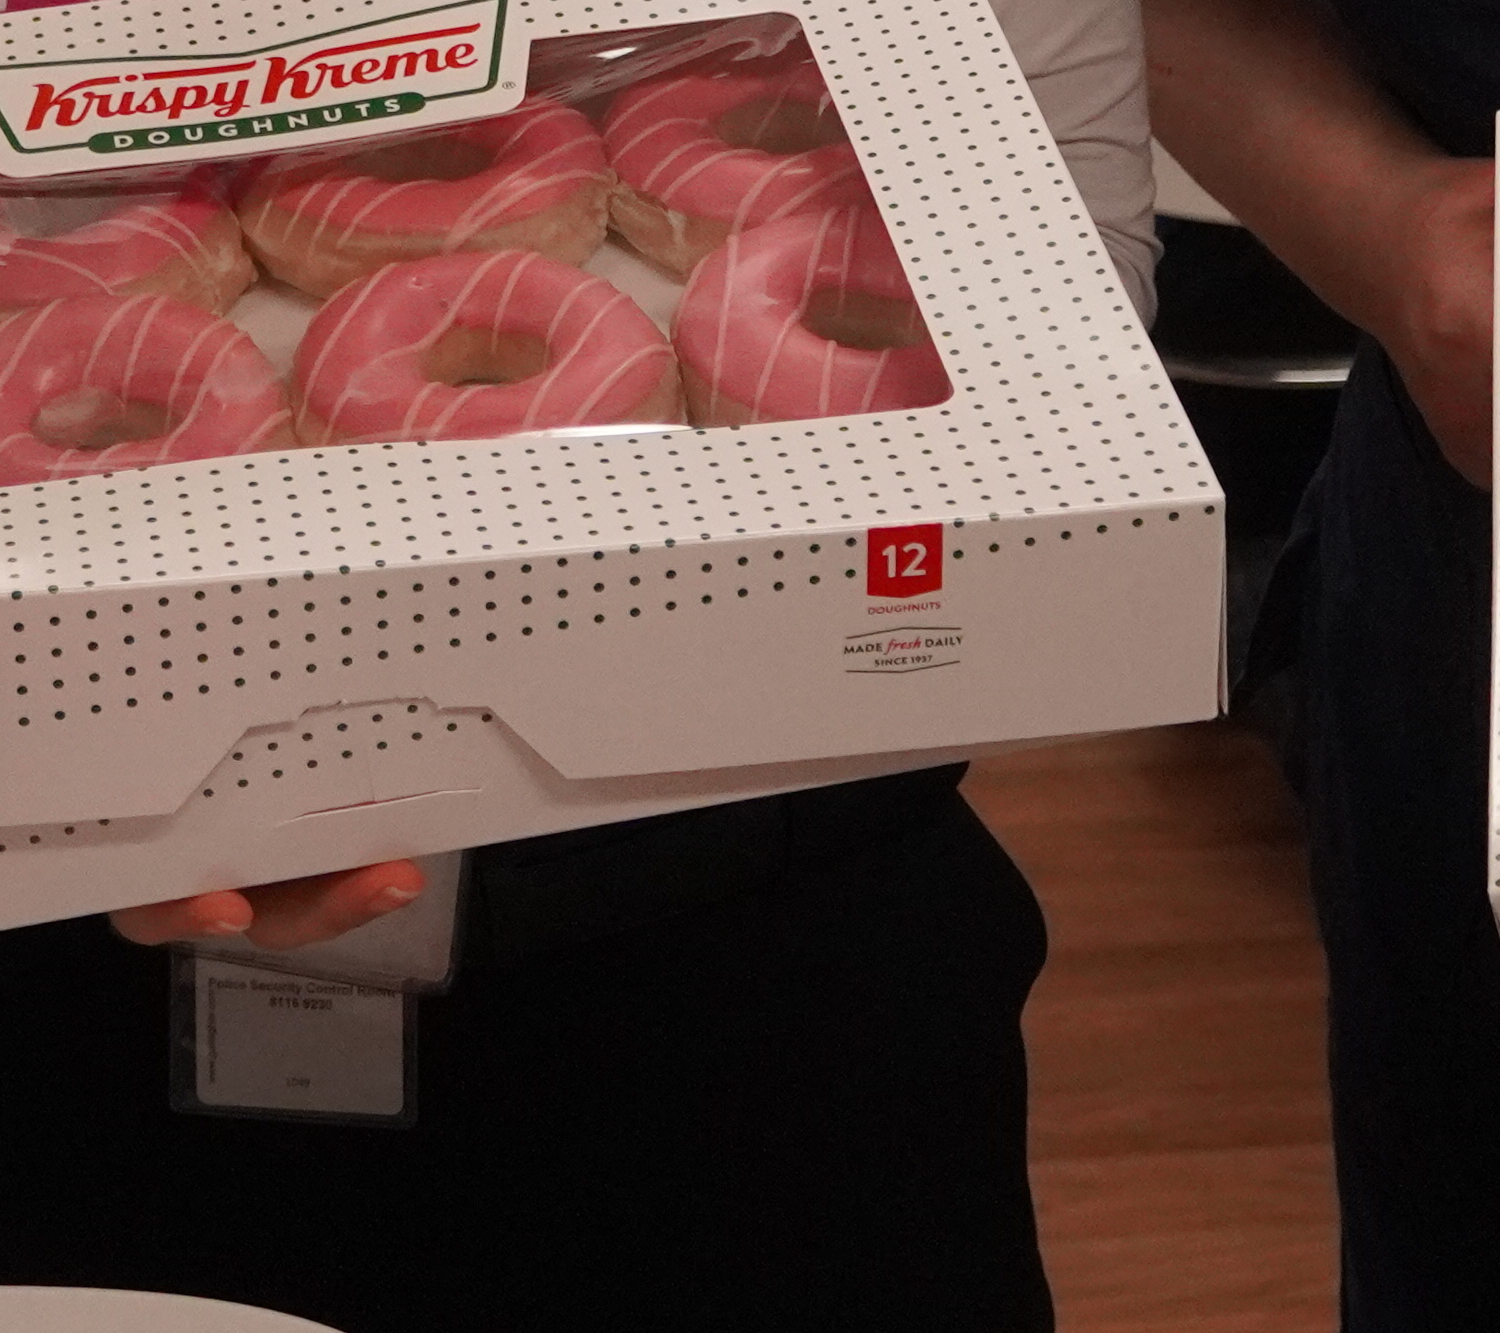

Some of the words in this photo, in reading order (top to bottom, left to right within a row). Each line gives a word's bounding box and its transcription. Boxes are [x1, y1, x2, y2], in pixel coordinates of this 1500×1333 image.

[23, 61, 258, 133] Krispy
[257, 22, 481, 107] Kreme
[112, 97, 402, 149] DOUGHNUTS
[882, 542, 928, 579] 12
[867, 601, 942, 616] DOUGHNUTS
[844, 642, 884, 655] MADE
[883, 636, 922, 656] fresh
[924, 635, 963, 648] DAILY
[874, 656, 909, 667] SINCE
[910, 654, 934, 664] 1937
[250, 979, 302, 996] Security
[306, 981, 355, 996] Control
